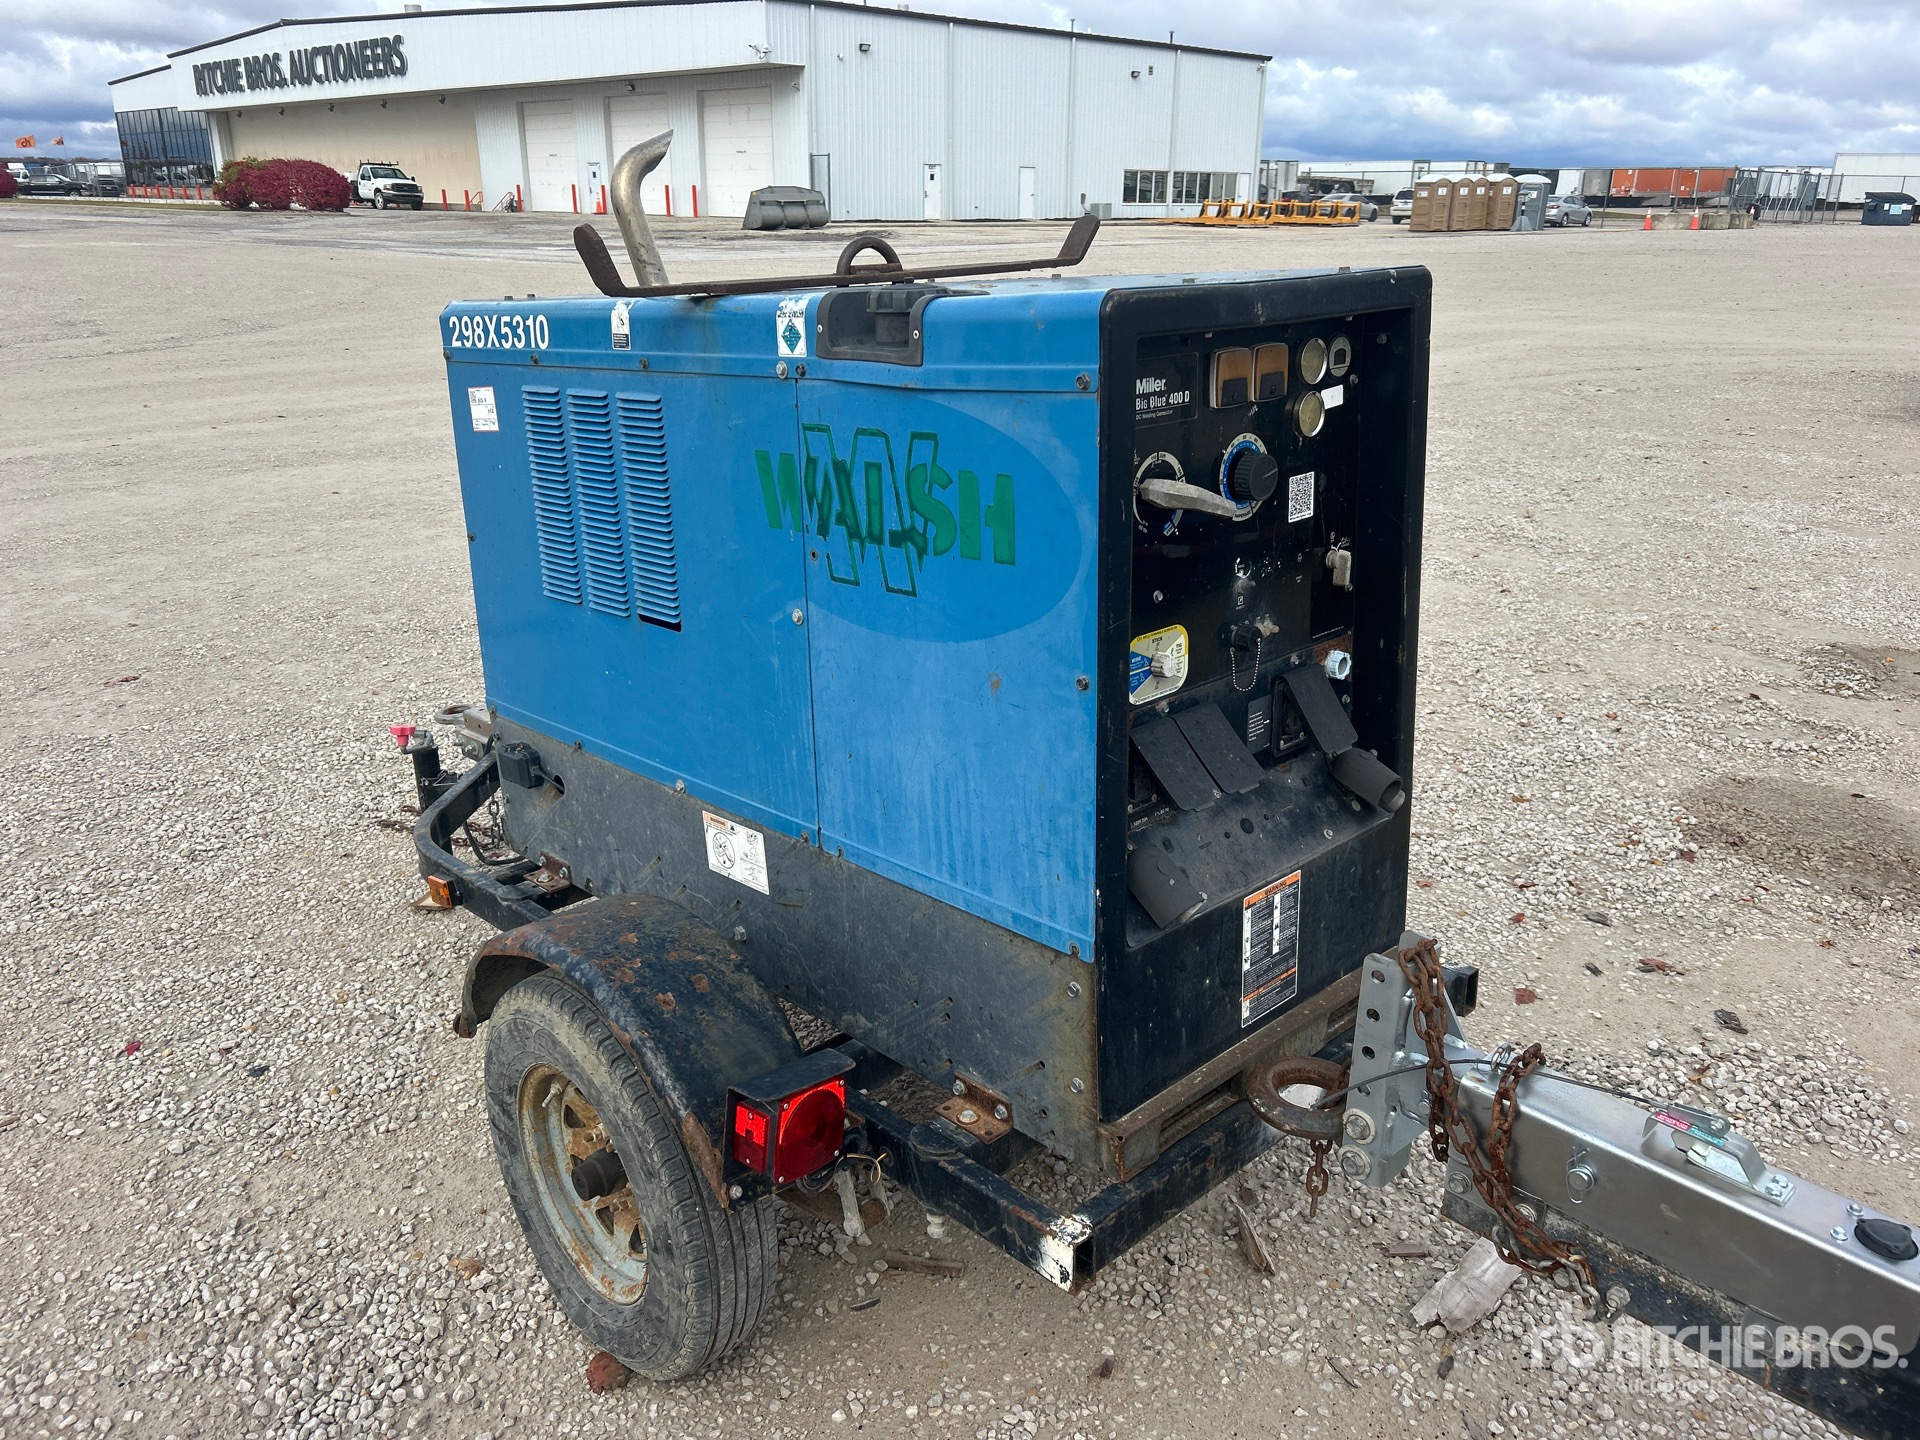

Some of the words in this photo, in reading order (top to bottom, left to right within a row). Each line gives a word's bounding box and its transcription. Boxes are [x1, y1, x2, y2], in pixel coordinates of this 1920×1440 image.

[192, 60, 246, 96] RITCHIE
[243, 52, 290, 91] BROS.
[289, 34, 409, 87] AUCTIONEERS
[448, 314, 550, 350] 298X5310
[1136, 377, 1167, 395] Miller
[1168, 392, 1183, 405] 400
[1184, 390, 1190, 403] D
[754, 449, 1016, 567] WALSH
